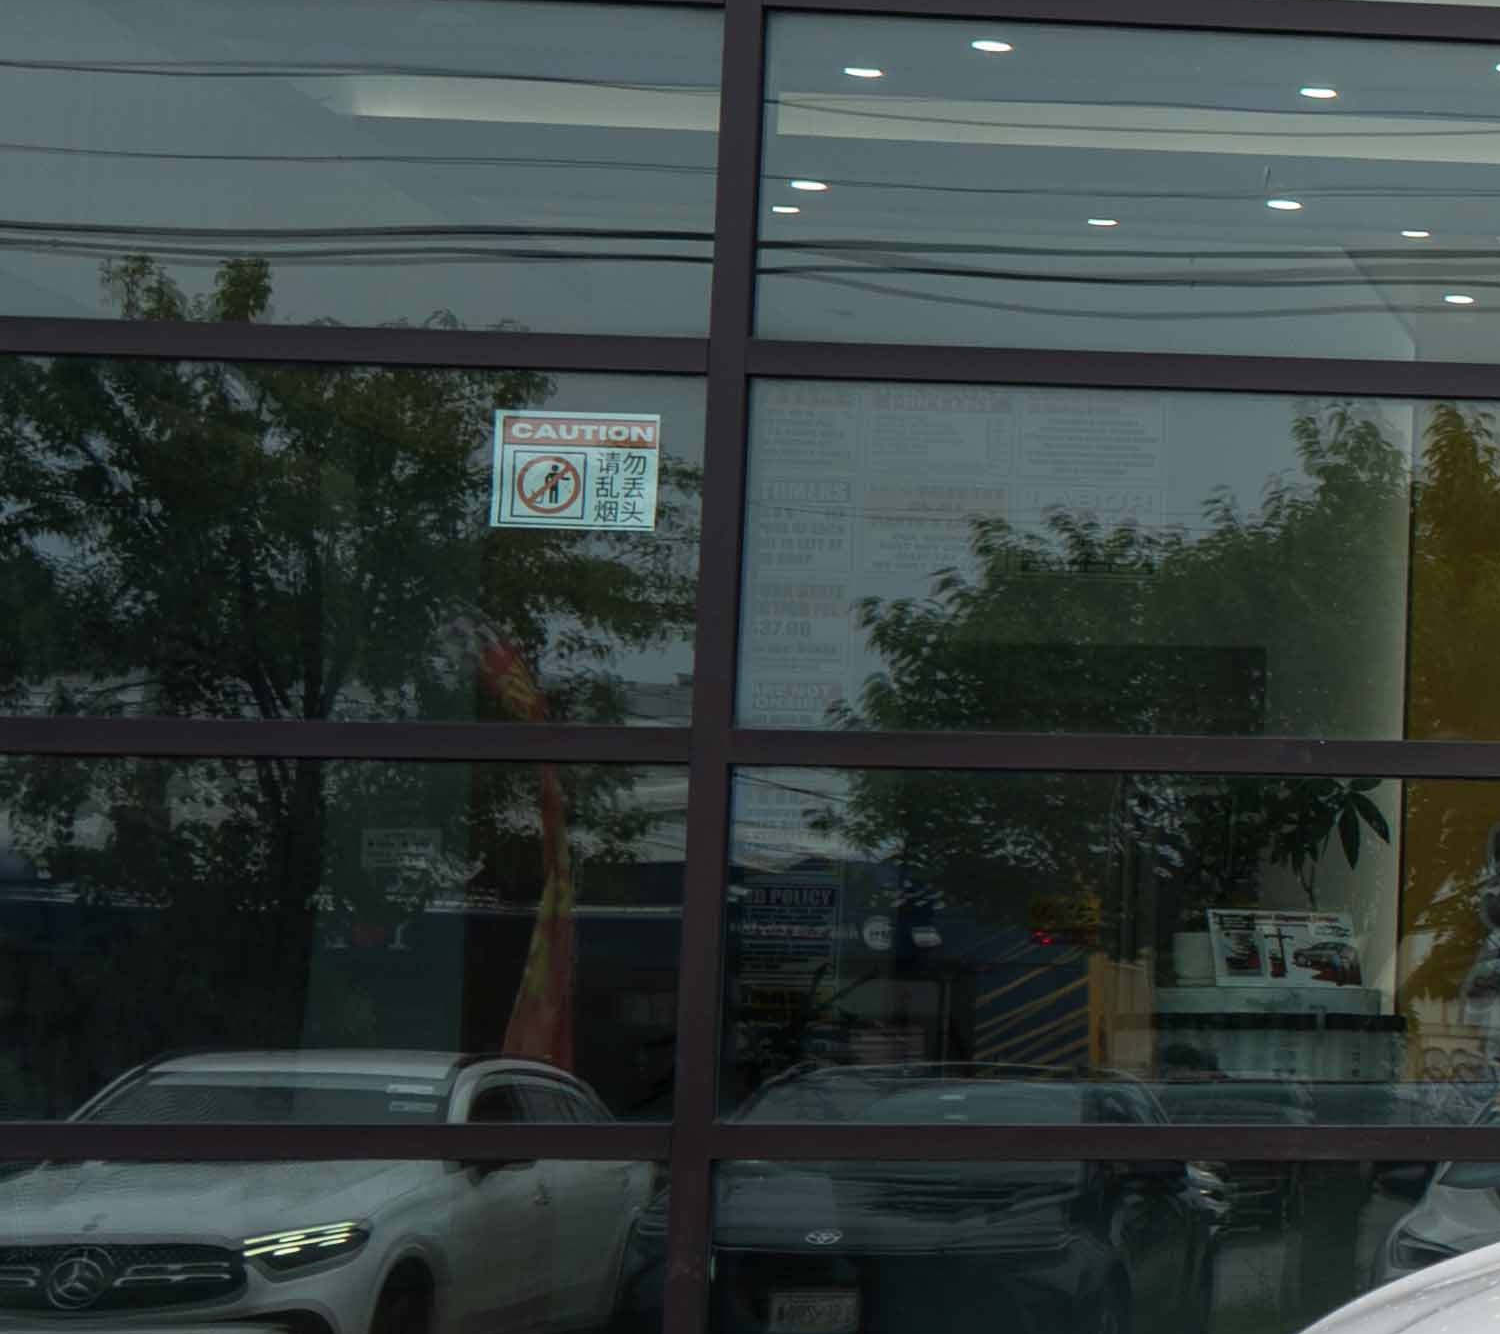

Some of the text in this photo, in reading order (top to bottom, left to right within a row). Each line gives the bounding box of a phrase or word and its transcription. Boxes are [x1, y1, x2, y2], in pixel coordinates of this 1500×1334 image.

[511, 422, 654, 443] CAUTION
[597, 451, 648, 475] 请勿
[595, 476, 646, 499] 乱丢
[593, 500, 644, 524] 烟头
